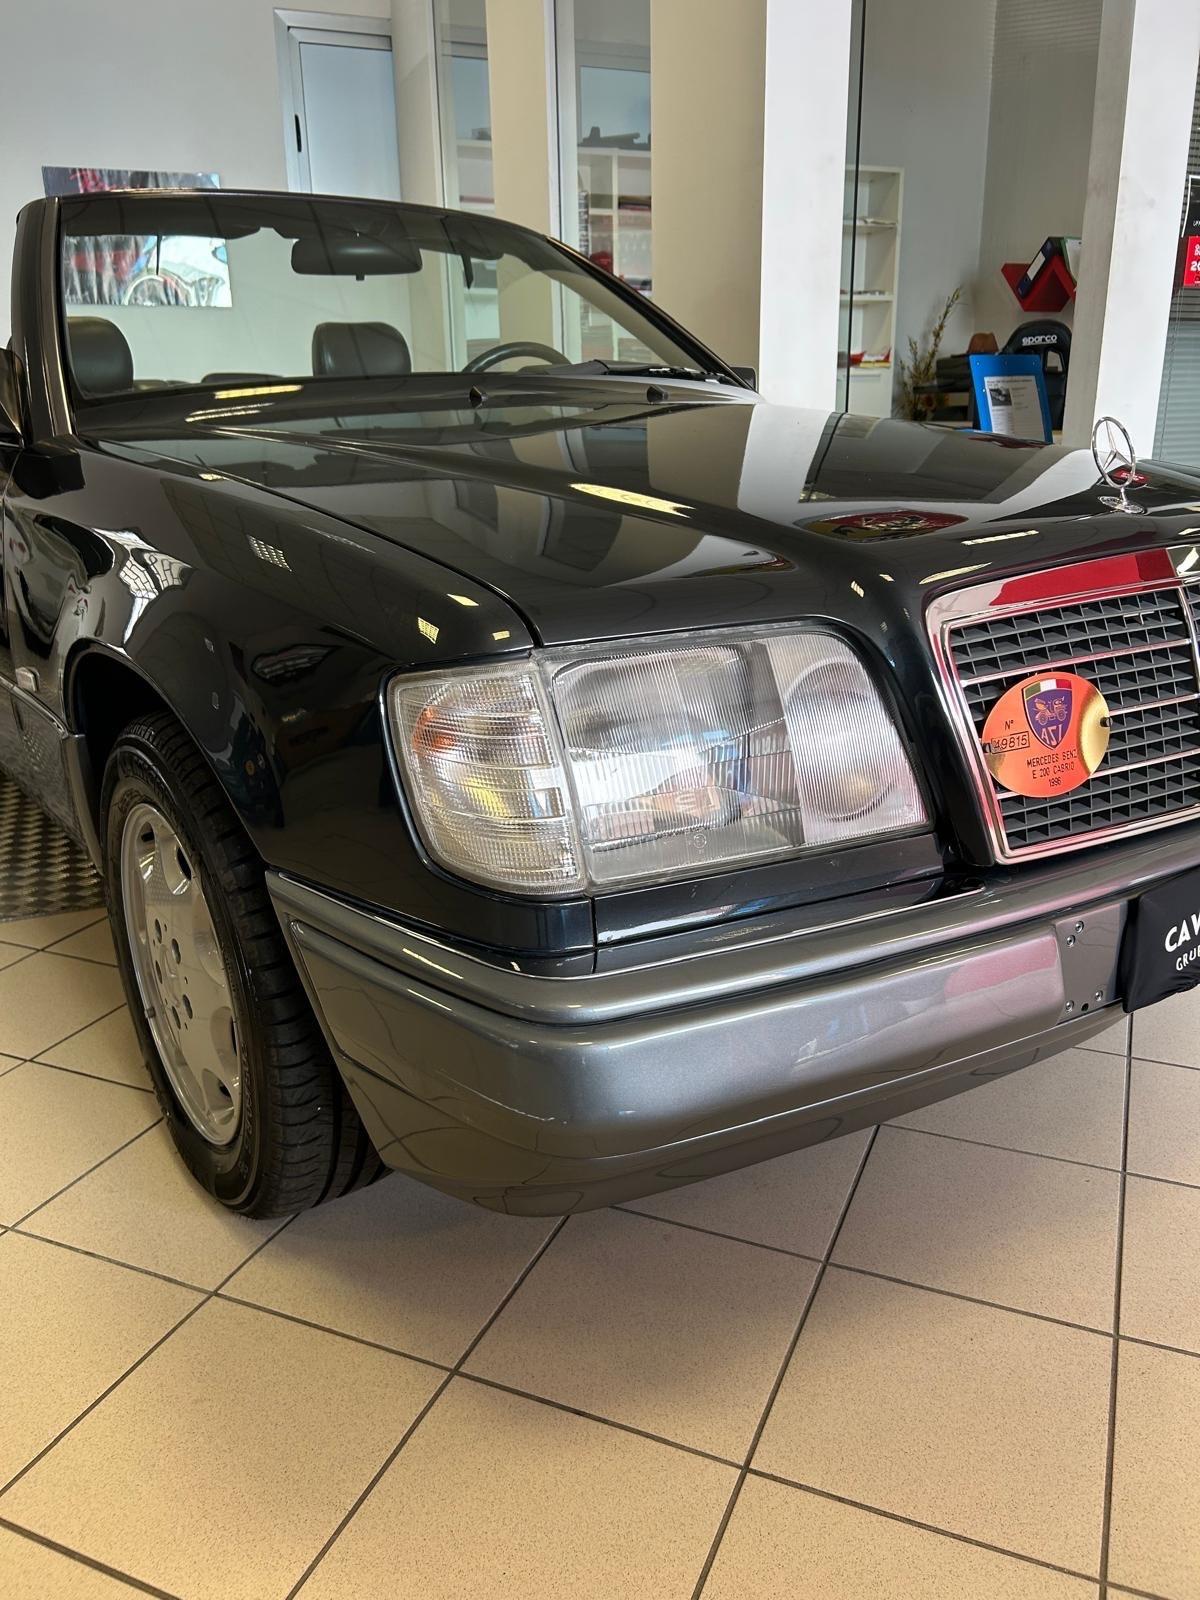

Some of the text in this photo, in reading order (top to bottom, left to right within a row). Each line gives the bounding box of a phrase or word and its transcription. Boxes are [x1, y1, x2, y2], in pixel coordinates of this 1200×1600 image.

[1022, 335, 1057, 346] sparco
[993, 734, 1027, 750] 49815
[1027, 749, 1077, 767] MERCEDES BENZ
[1032, 761, 1075, 780] E 200 CABRIO
